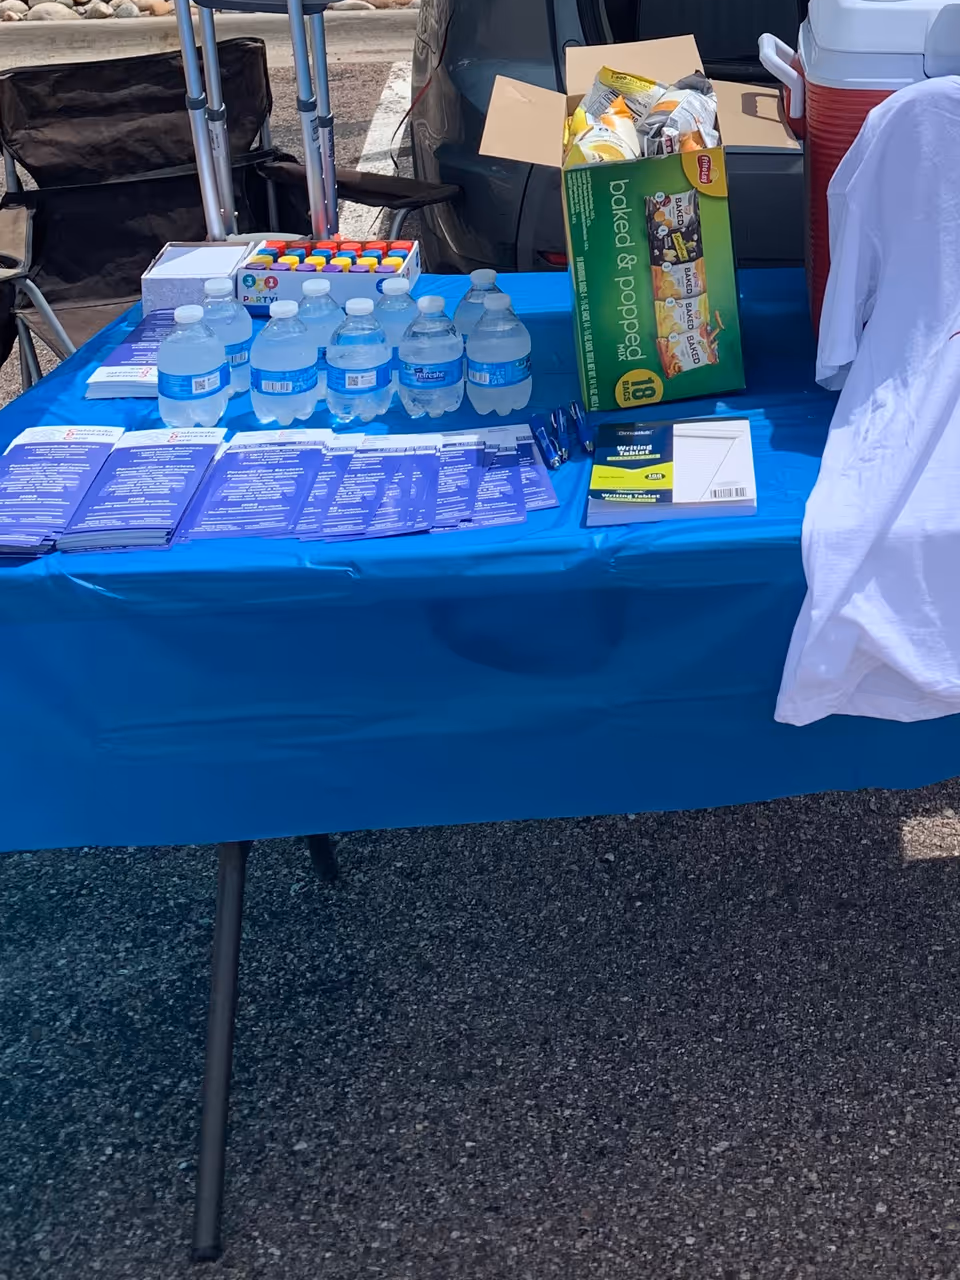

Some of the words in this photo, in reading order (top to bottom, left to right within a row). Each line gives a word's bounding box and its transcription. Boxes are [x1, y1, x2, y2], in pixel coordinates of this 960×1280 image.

[610, 179, 636, 248] baked
[674, 197, 684, 226] BAKED
[617, 253, 638, 270] &
[684, 267, 693, 295] BAKED
[614, 276, 647, 360] popped
[685, 302, 694, 330] BAKED
[616, 344, 628, 362] MIX
[686, 334, 701, 365] BAKED
[622, 380, 630, 402] BAGS
[630, 376, 657, 401] 18
[616, 444, 652, 452] Writing
